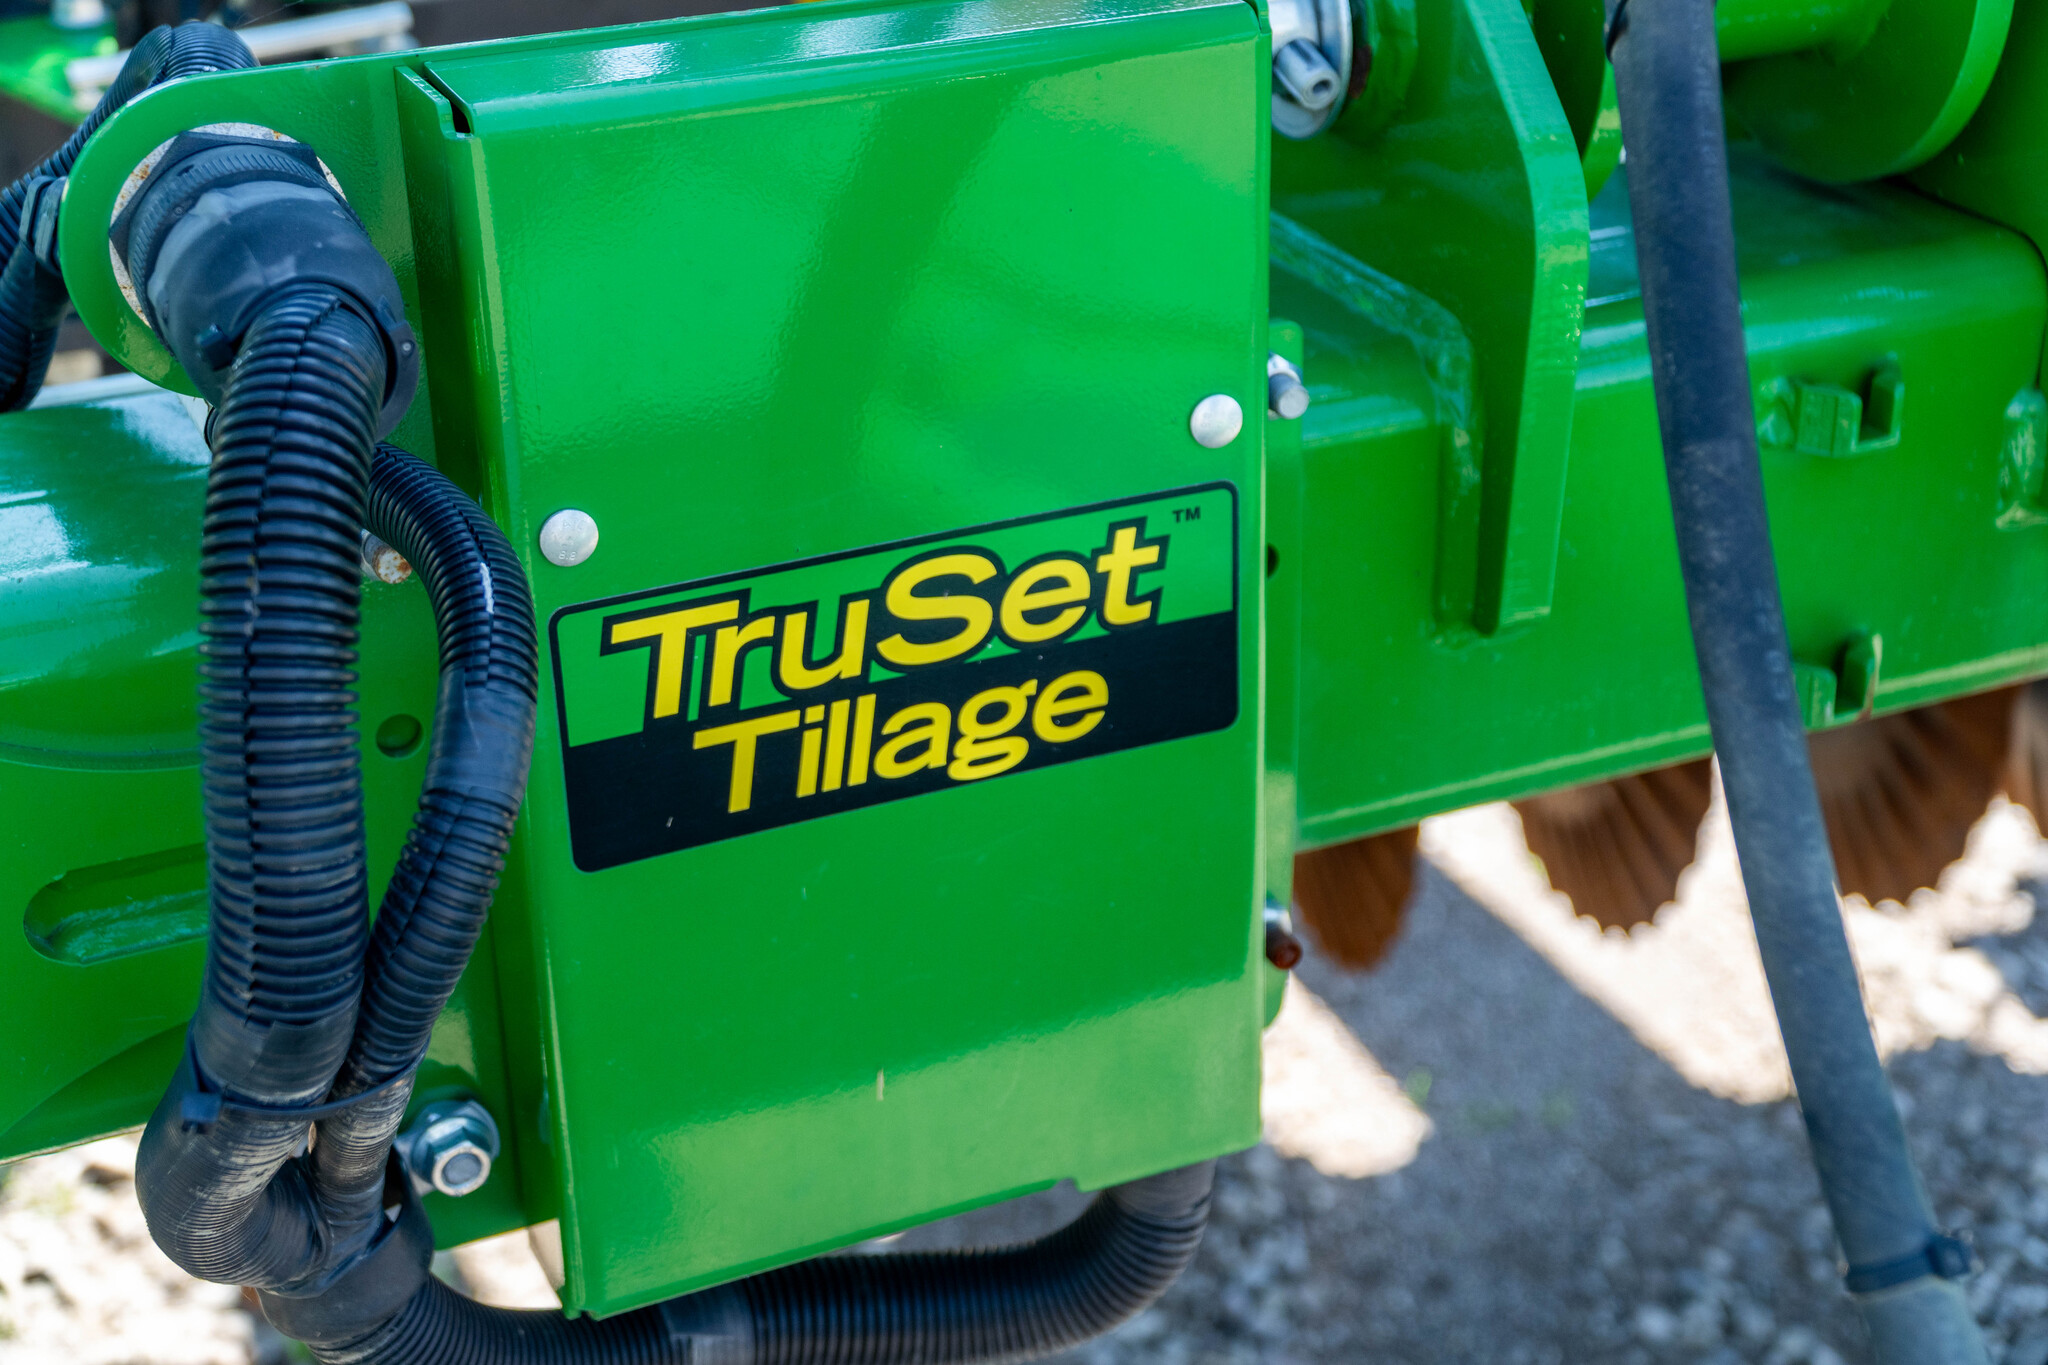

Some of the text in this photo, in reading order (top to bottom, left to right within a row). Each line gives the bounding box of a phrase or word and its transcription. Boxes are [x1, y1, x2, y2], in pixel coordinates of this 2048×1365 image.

[610, 506, 1201, 720] TruSet TM
[692, 669, 1110, 814] Tillage
